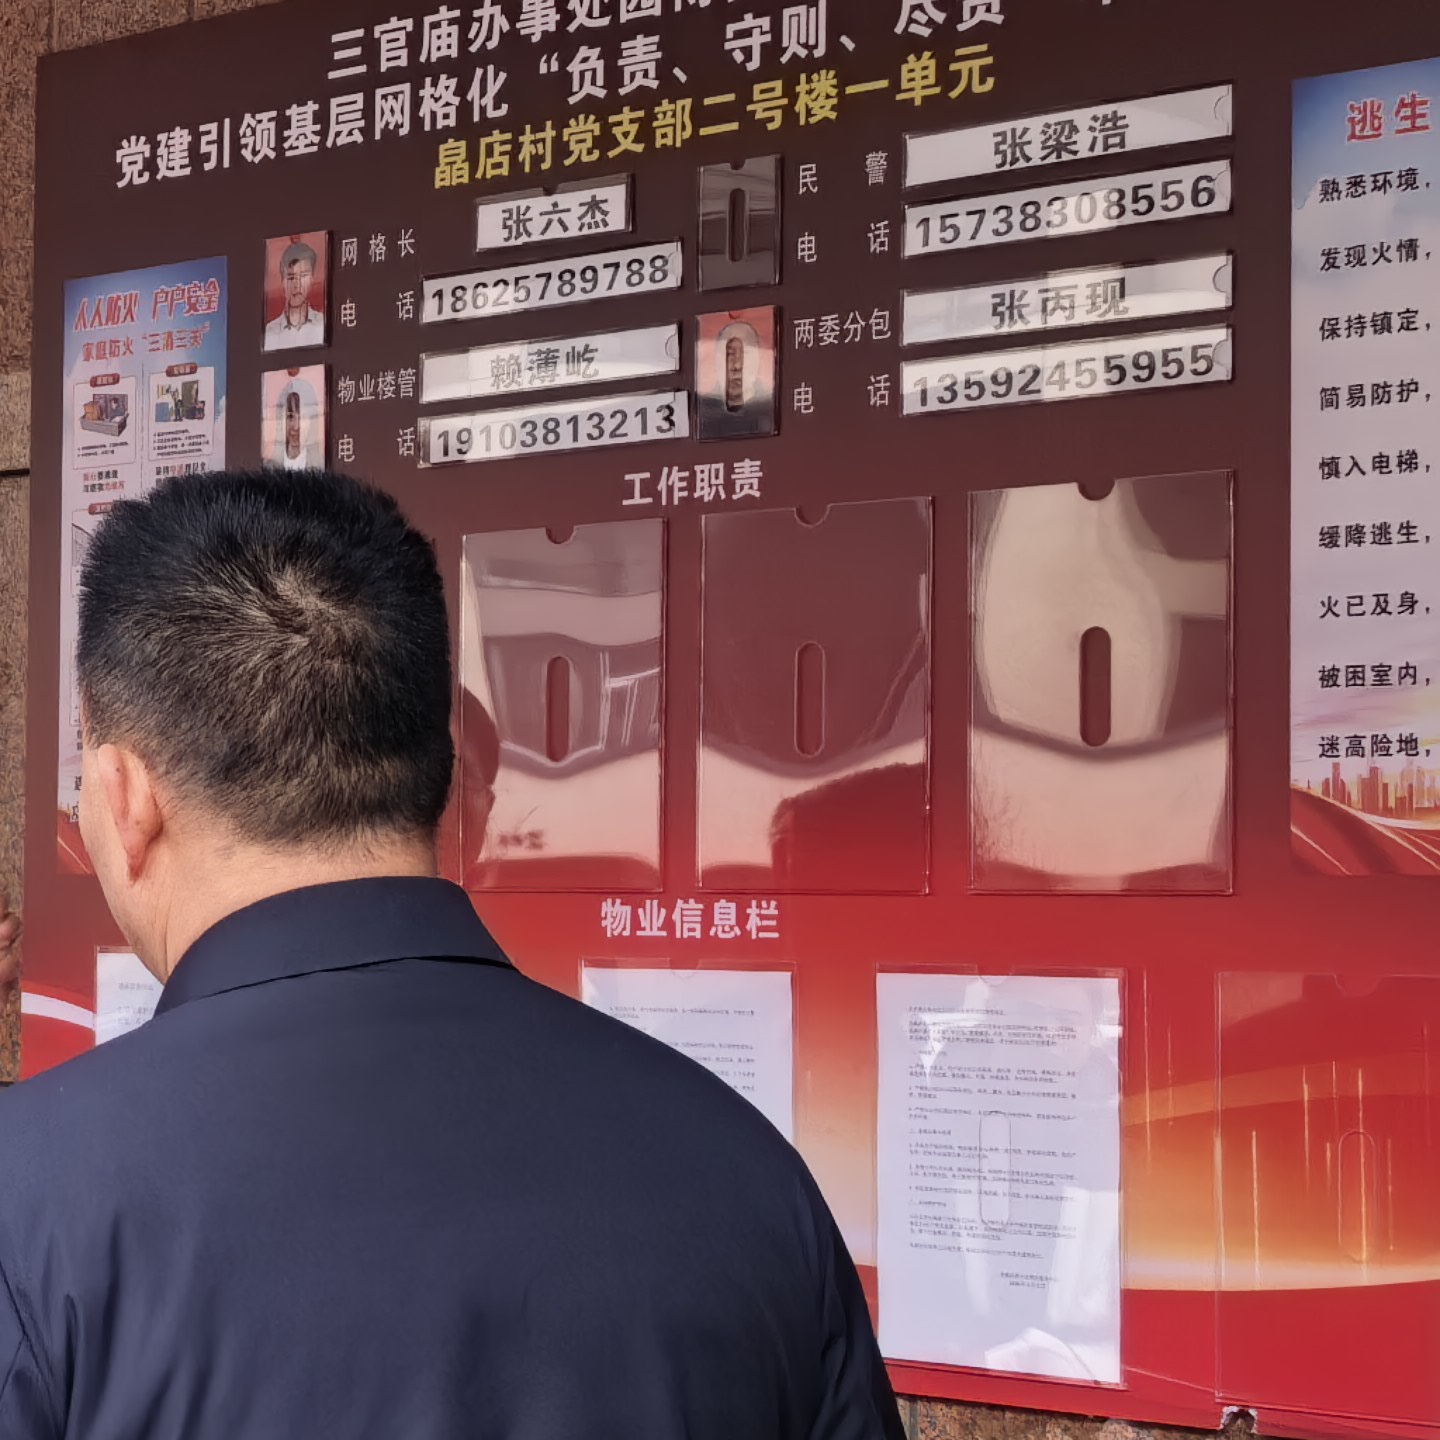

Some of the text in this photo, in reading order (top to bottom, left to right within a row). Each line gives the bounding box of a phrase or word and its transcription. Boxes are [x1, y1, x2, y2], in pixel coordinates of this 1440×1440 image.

[993, 109, 1129, 169] 张梁浩
[798, 150, 889, 195] 民警
[501, 194, 611, 243] 张六杰
[916, 175, 1217, 248] 15738308556
[340, 229, 416, 267] 网格长
[797, 220, 890, 264] 电话
[431, 255, 670, 316] 18625789788
[991, 277, 1130, 331] 张丙现
[340, 291, 416, 328] 电话
[793, 307, 892, 350] 两委分包
[338, 368, 417, 405] 物业楼管
[793, 374, 891, 415] 电话
[913, 343, 1215, 408] 13592455955
[338, 427, 417, 463] 电话
[436, 404, 676, 458] 19103813213
[622, 458, 763, 506] 工作职责
[600, 898, 780, 940] 物业信息栏
